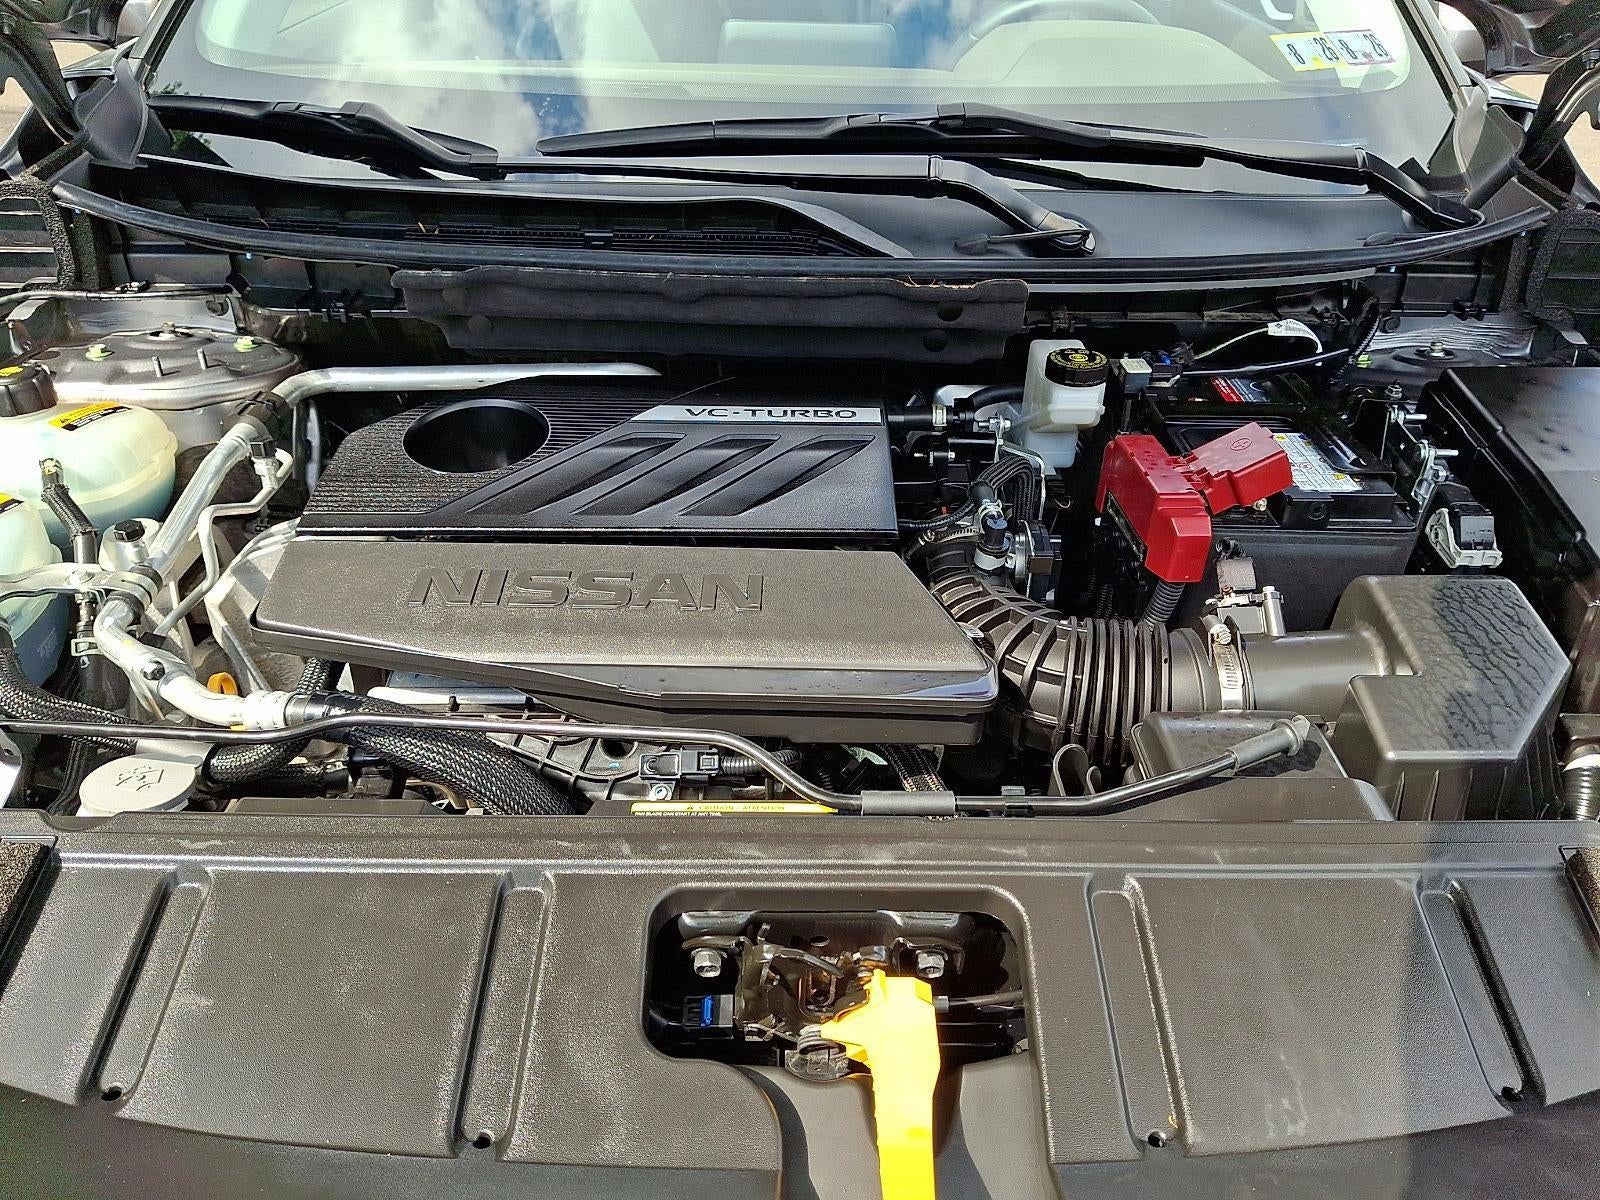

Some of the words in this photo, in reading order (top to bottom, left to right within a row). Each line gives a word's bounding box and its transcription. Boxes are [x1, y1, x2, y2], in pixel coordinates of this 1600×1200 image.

[1287, 43, 1306, 65] 8
[1312, 37, 1340, 62] 26
[1338, 39, 1358, 60] 8
[685, 407, 857, 420] VC-TURBO
[409, 569, 764, 611] NISSAN
